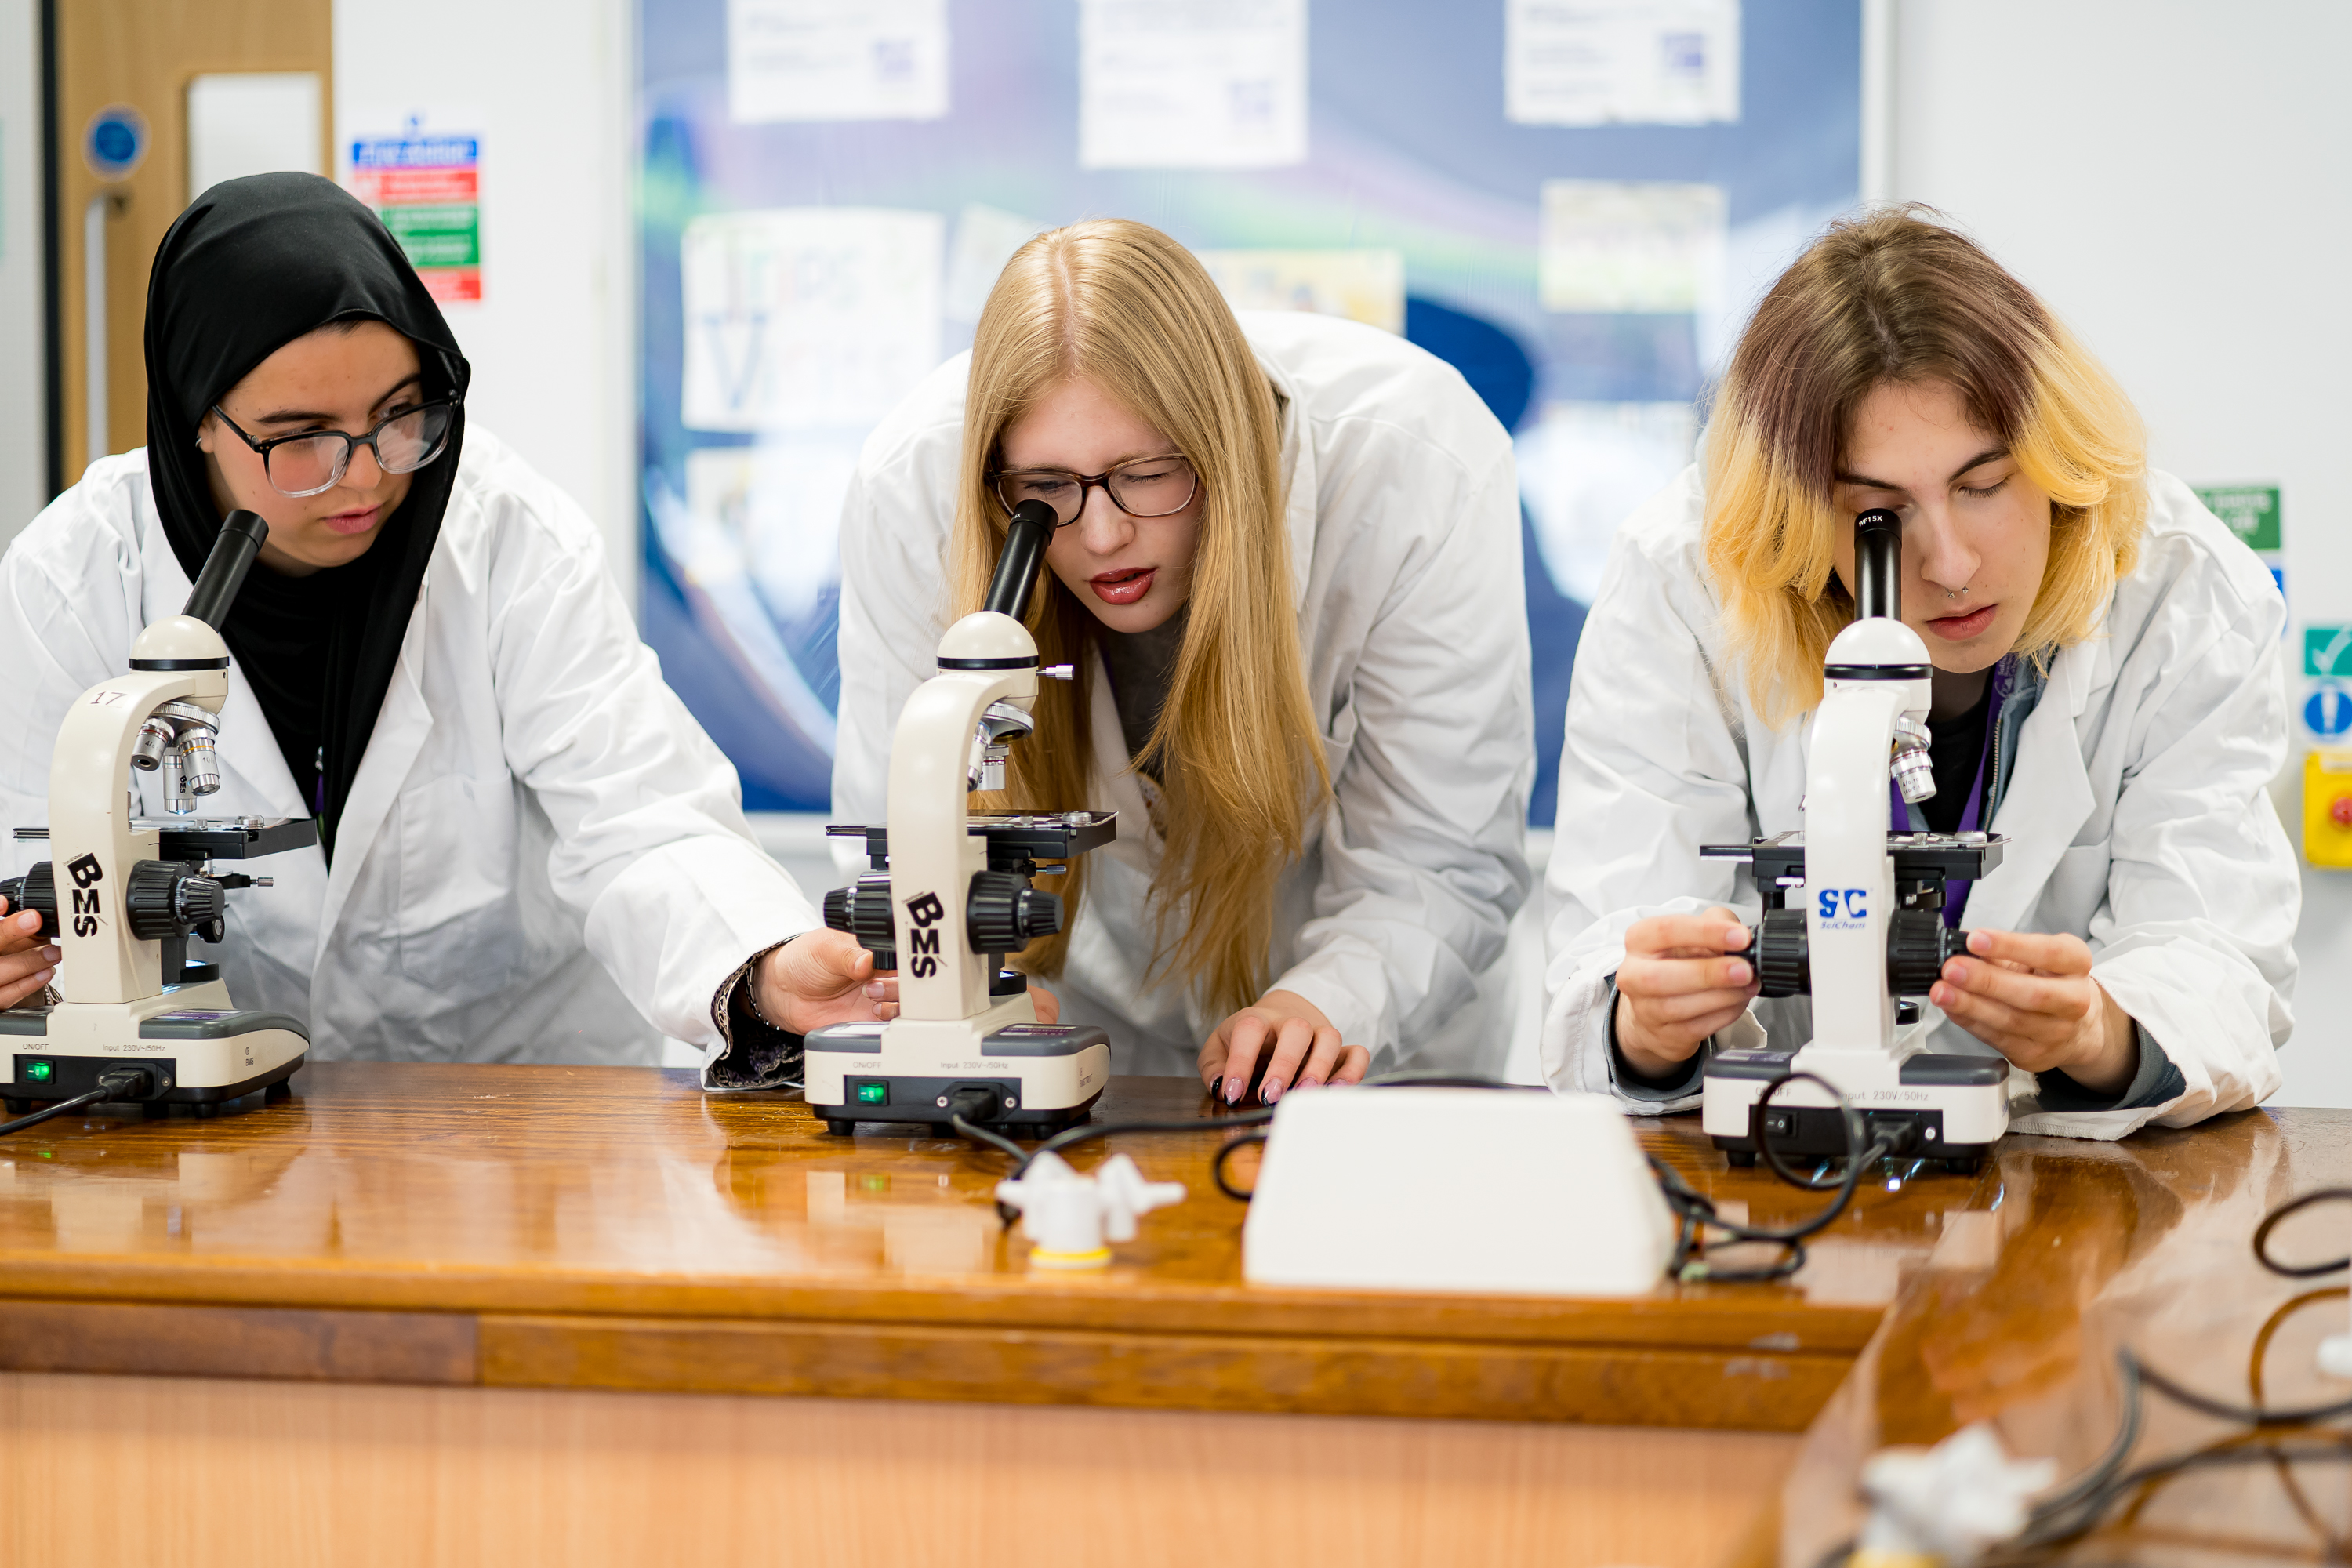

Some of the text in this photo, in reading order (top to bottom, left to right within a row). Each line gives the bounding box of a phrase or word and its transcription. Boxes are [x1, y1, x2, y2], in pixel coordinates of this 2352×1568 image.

[1858, 515, 1883, 527] WF15X
[89, 691, 128, 706] 17
[67, 852, 103, 938] BMS
[1820, 920, 1866, 930] SciChem
[906, 891, 945, 979] BMS
[940, 1062, 959, 1070] Input
[1755, 1087, 1791, 1097] OOFF
[1842, 1091, 1929, 1102] nput 230V/50Hz
